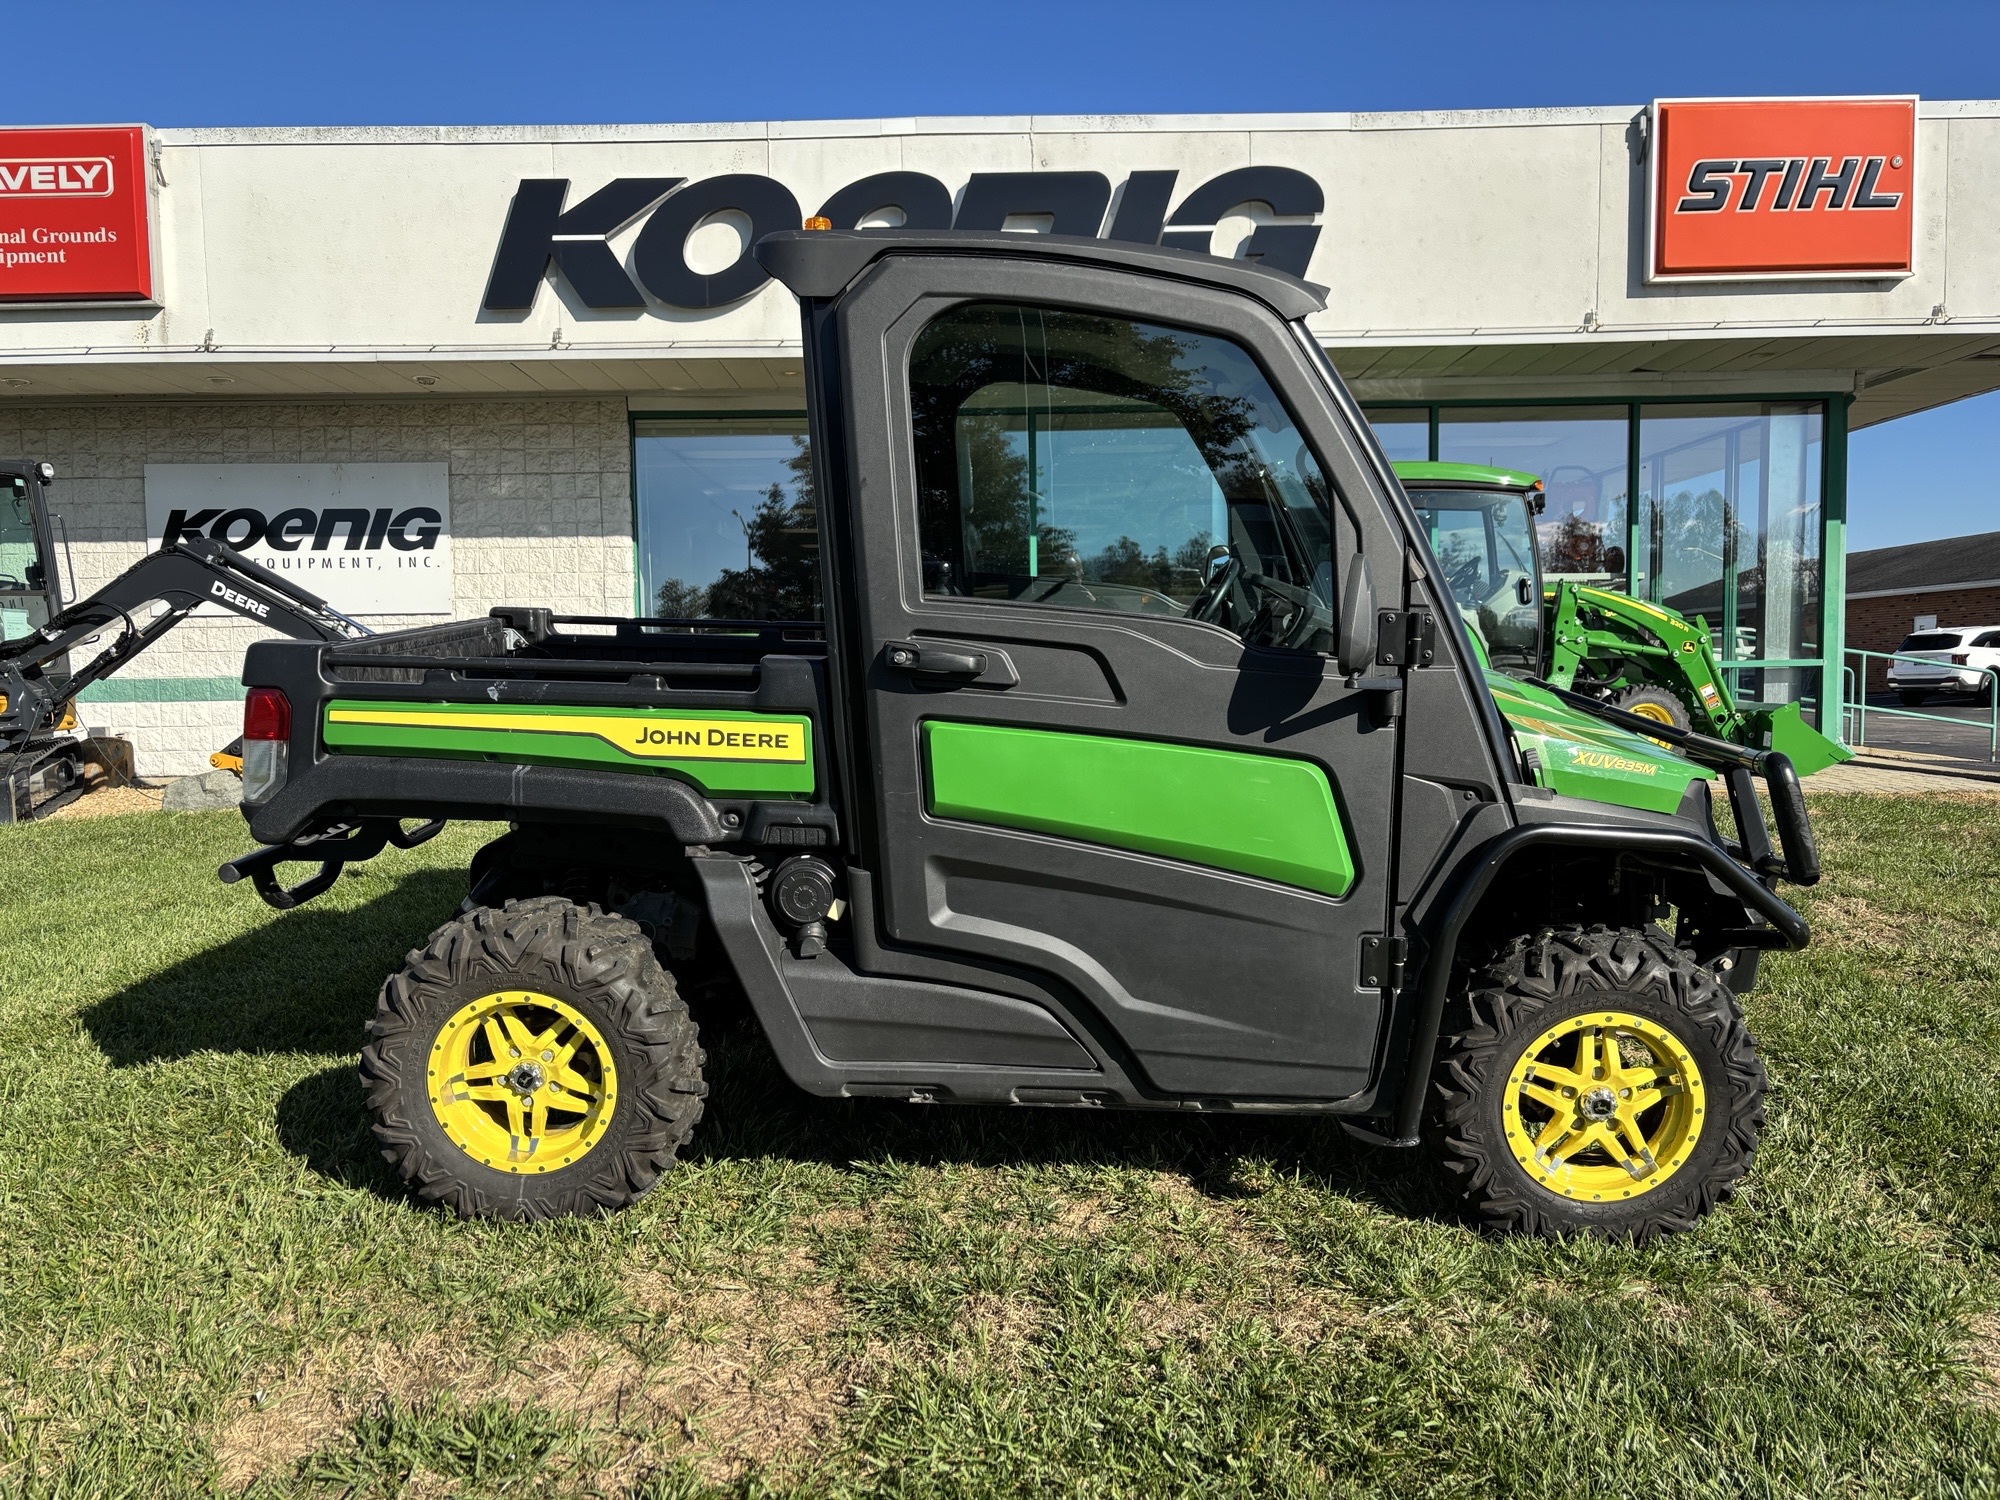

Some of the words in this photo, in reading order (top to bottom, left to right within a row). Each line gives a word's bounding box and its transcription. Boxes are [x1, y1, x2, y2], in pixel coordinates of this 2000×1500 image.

[1674, 156, 1904, 214] STIHL
[32, 227, 117, 244] Grounds
[398, 556, 441, 569] INC.
[210, 580, 271, 618] DEERE
[635, 726, 701, 746] JOHN
[707, 728, 789, 749] DEERE
[1571, 750, 1658, 776] XUV835M
